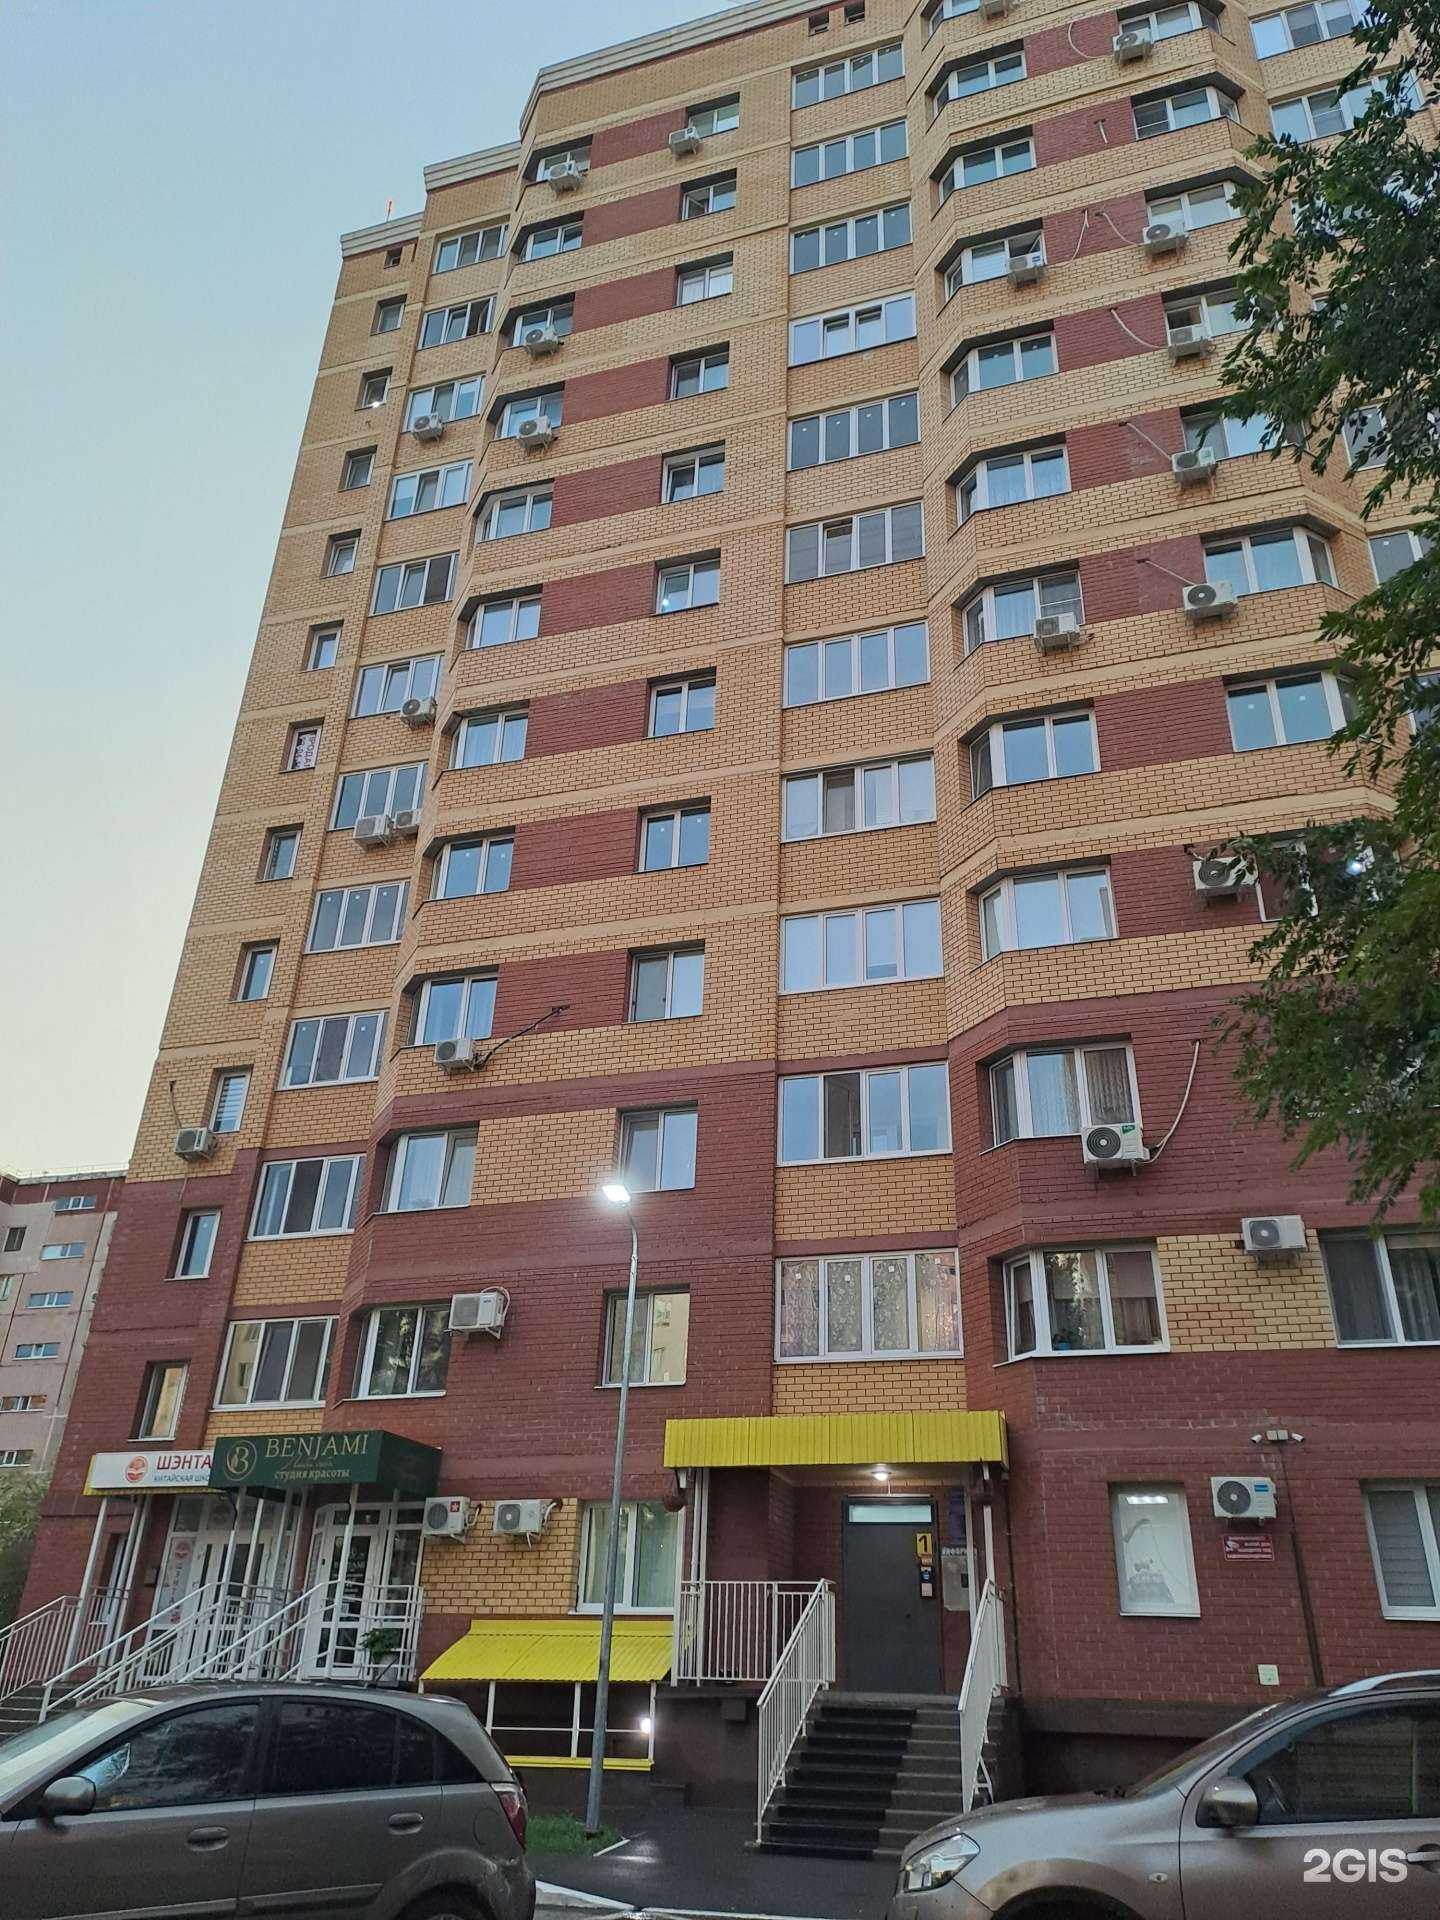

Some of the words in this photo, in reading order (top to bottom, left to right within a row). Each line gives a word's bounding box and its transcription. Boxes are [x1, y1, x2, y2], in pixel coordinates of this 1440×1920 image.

[265, 1434, 369, 1462] BENJAMI
[156, 1454, 213, 1470] ШЭНТА
[274, 1470, 307, 1482] студия
[308, 1469, 350, 1481] красоты
[918, 1535, 928, 1552] 1
